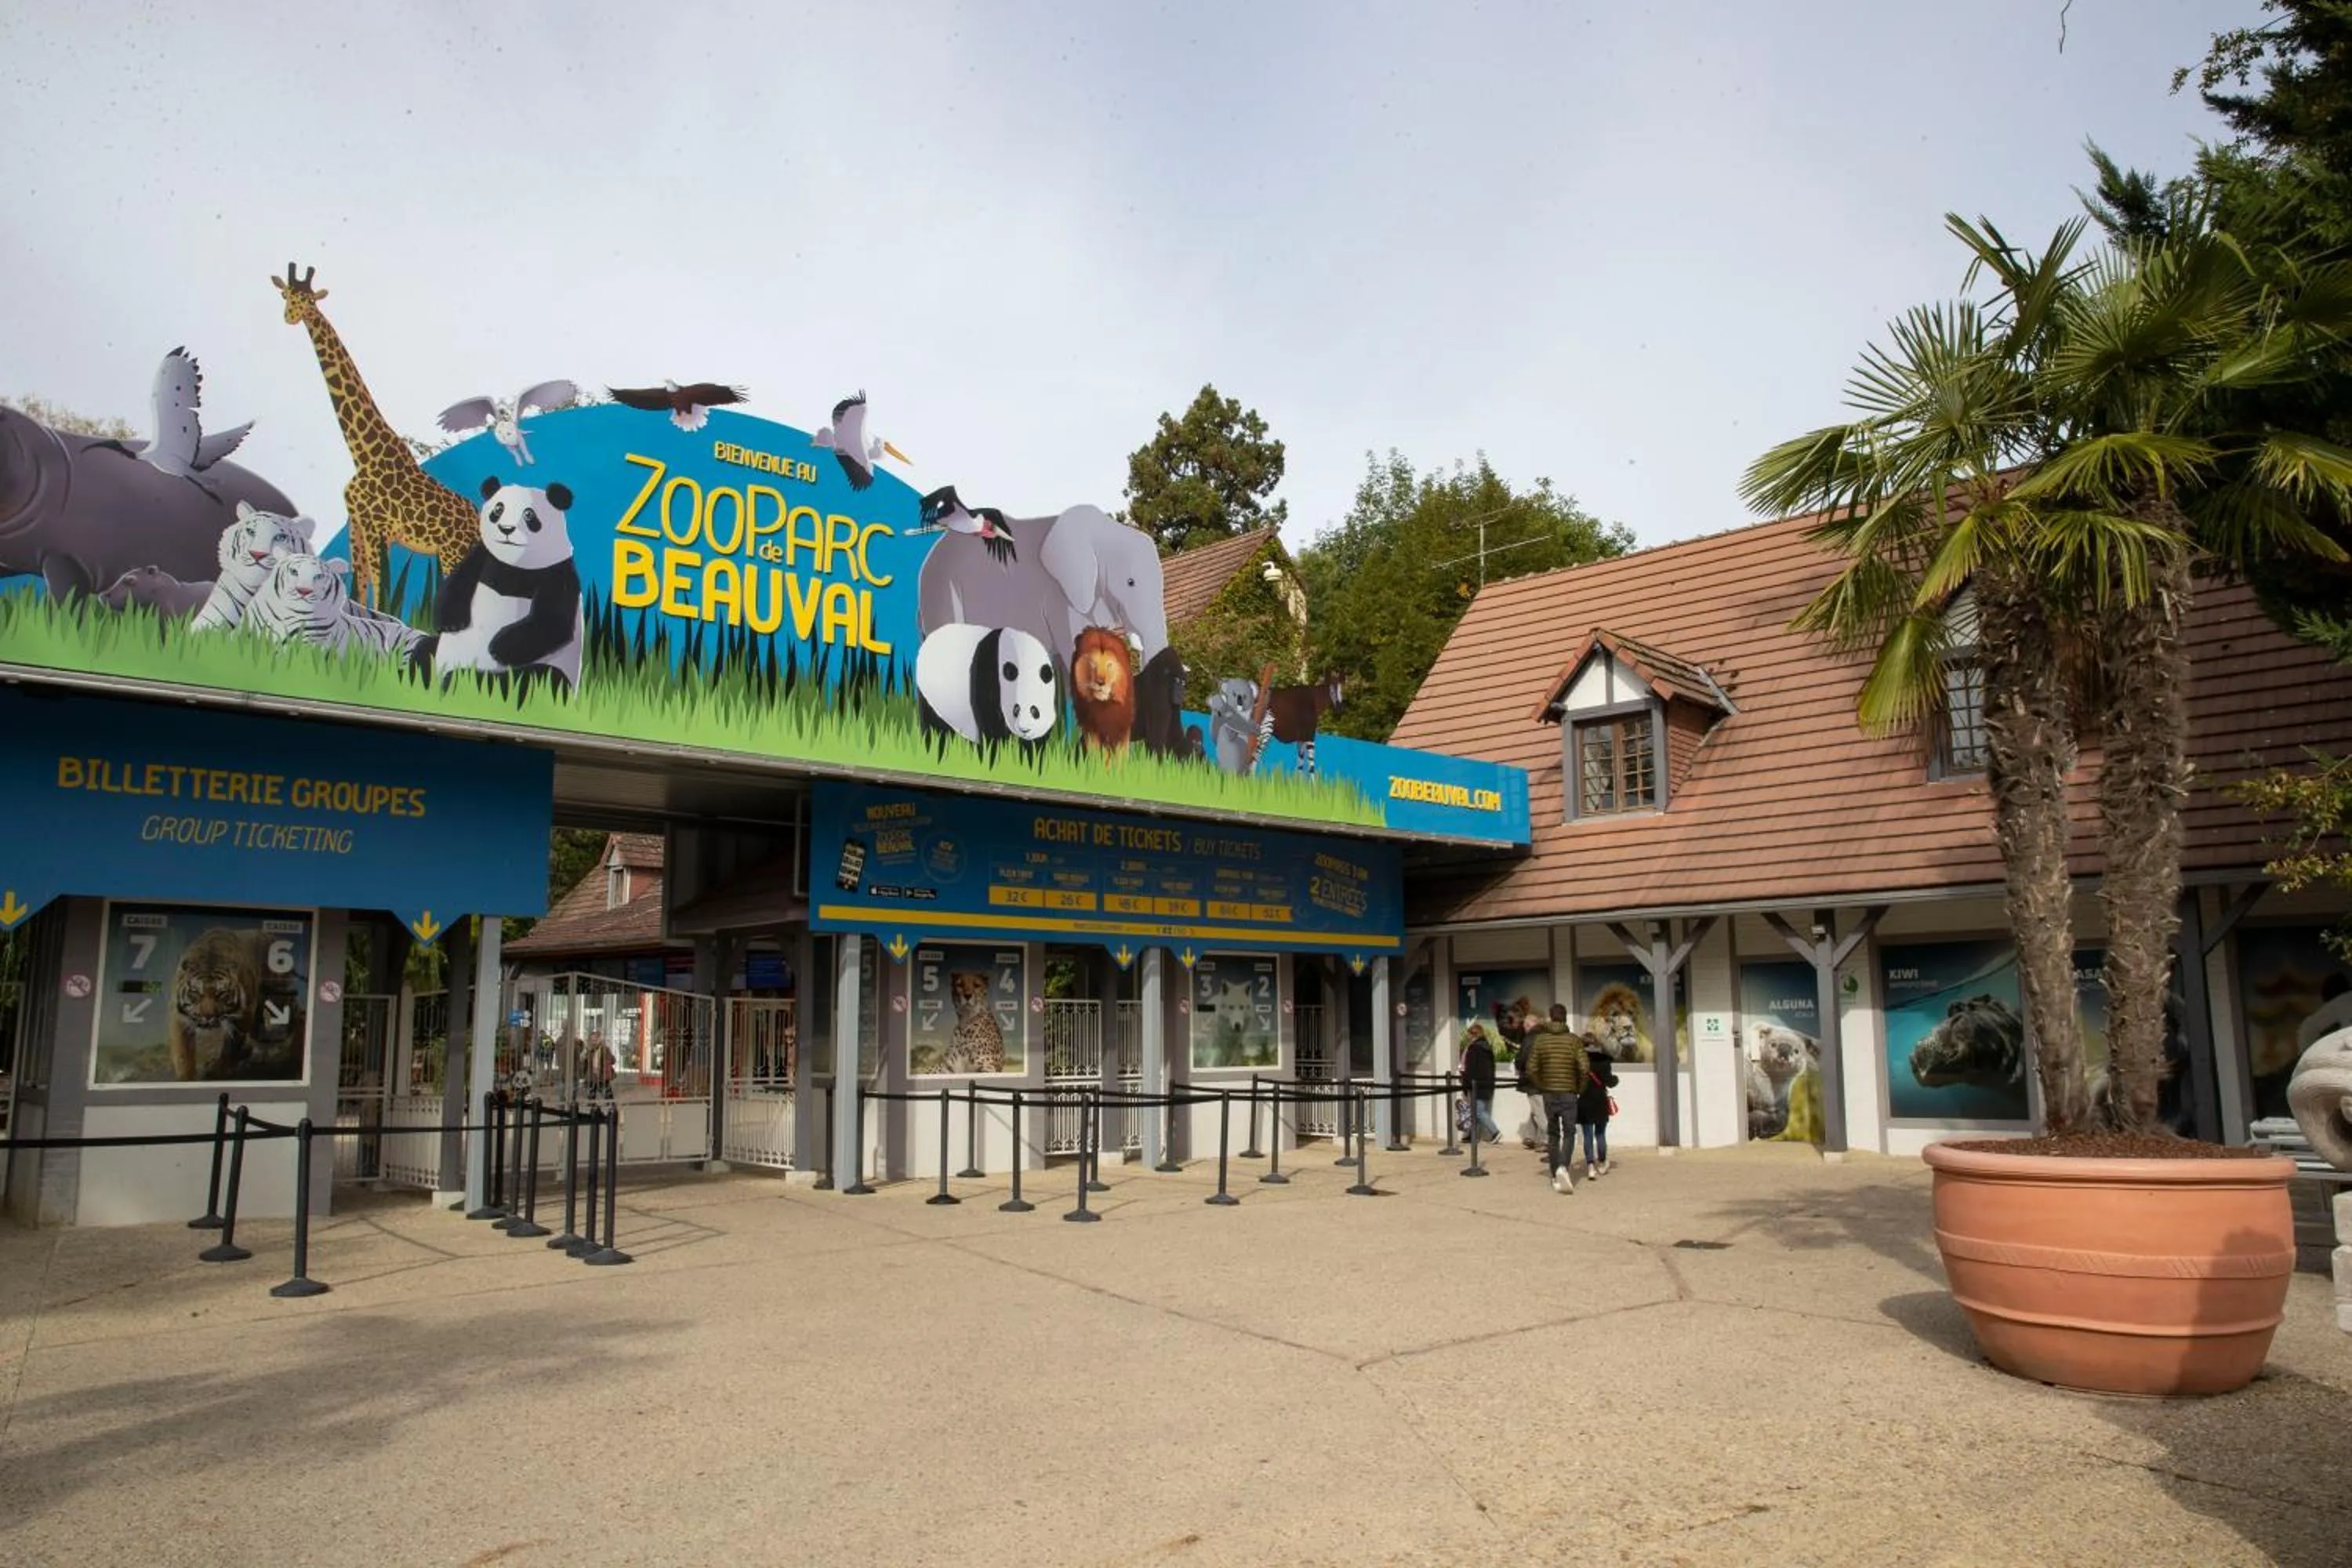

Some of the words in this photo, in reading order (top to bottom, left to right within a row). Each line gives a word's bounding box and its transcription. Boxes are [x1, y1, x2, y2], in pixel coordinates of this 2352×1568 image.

[714, 441, 794, 477] BIENVENUE
[796, 461, 817, 483] AU
[615, 452, 895, 587] ZOOPARC
[758, 539, 784, 563] de
[612, 539, 891, 655] BEAUVAL
[56, 756, 284, 806] BILLETTERIE
[291, 778, 427, 818] GROUPES
[141, 815, 228, 844] GROUP
[233, 823, 355, 854] TICKETING
[1033, 817, 1088, 844] ACHAT
[1093, 823, 1115, 846] DE
[1119, 826, 1182, 853] TICKETS
[1193, 837, 1216, 856] BUY
[1218, 840, 1262, 861] TICKETS
[129, 935, 157, 970] 7
[267, 941, 295, 974] 6
[922, 965, 939, 993] 5
[998, 968, 1015, 993] 4
[1200, 975, 1213, 997] 3
[1258, 975, 1270, 998] 2
[1888, 968, 1919, 980] KIWI
[1467, 988, 1477, 1009] 1
